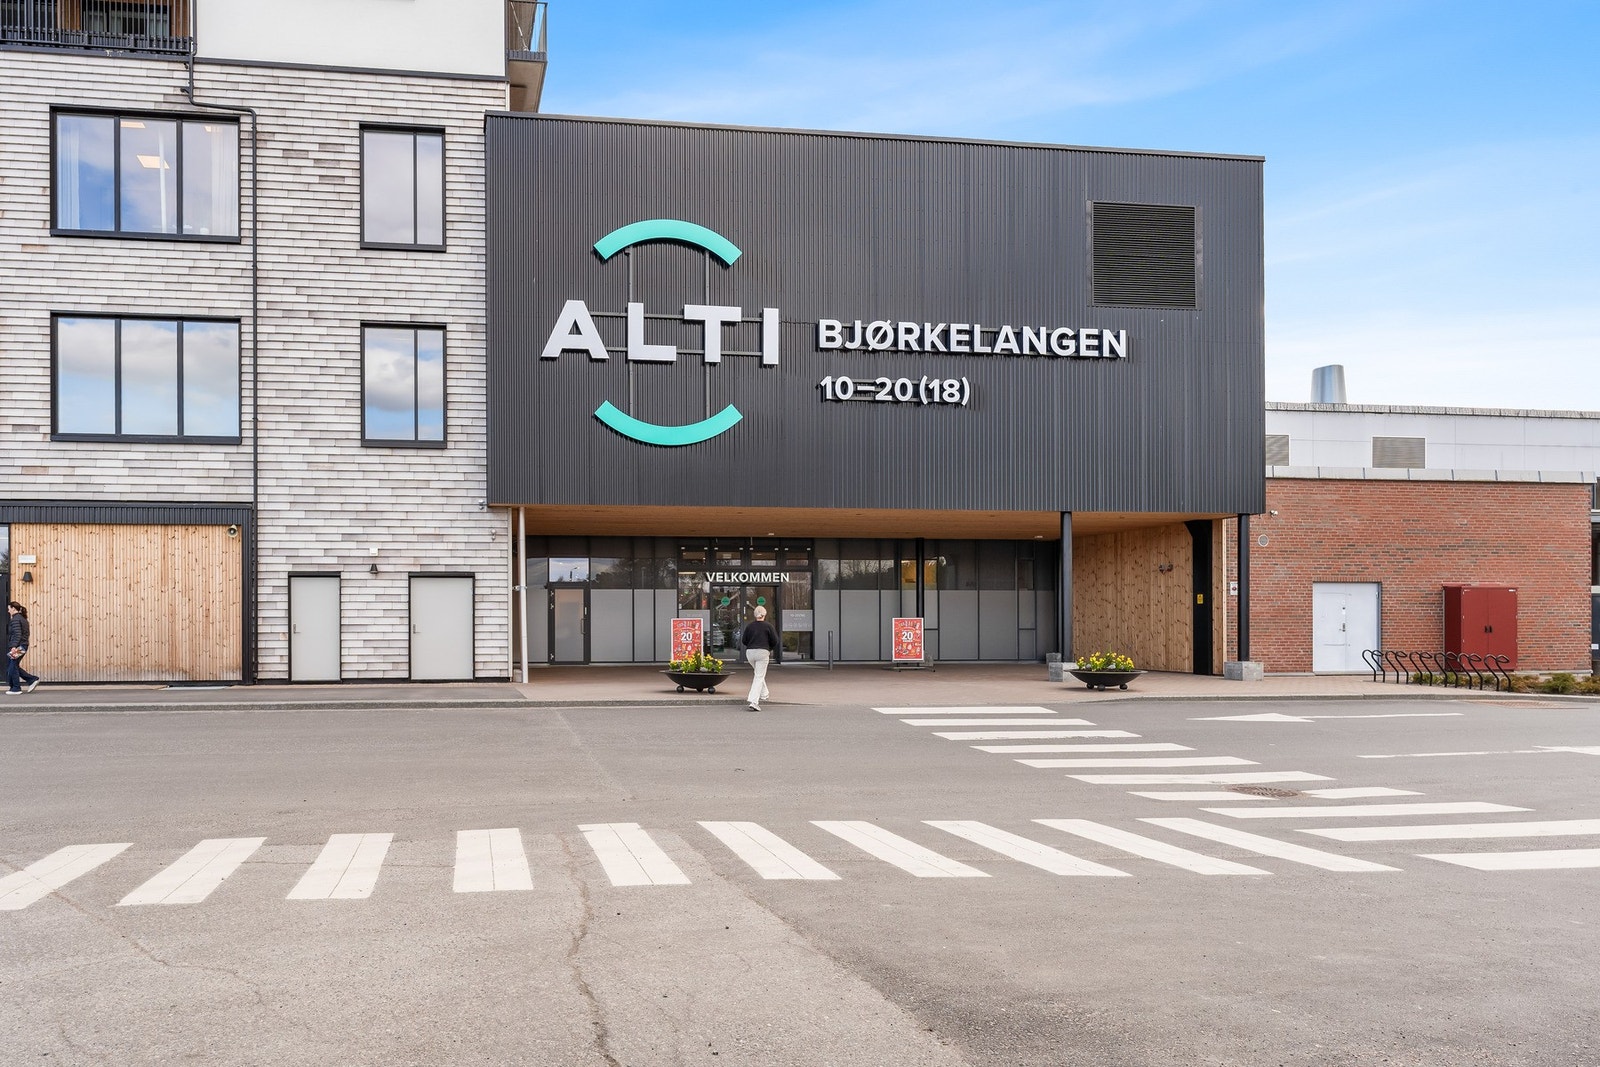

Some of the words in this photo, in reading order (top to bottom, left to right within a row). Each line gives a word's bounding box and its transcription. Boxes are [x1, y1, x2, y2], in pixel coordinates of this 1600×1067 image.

[541, 299, 780, 366] ALTI
[819, 318, 1127, 359] BJØRKELANGEN
[705, 571, 790, 584] VELKOMMEN
[680, 631, 693, 642] 20
[901, 630, 914, 641] 20
